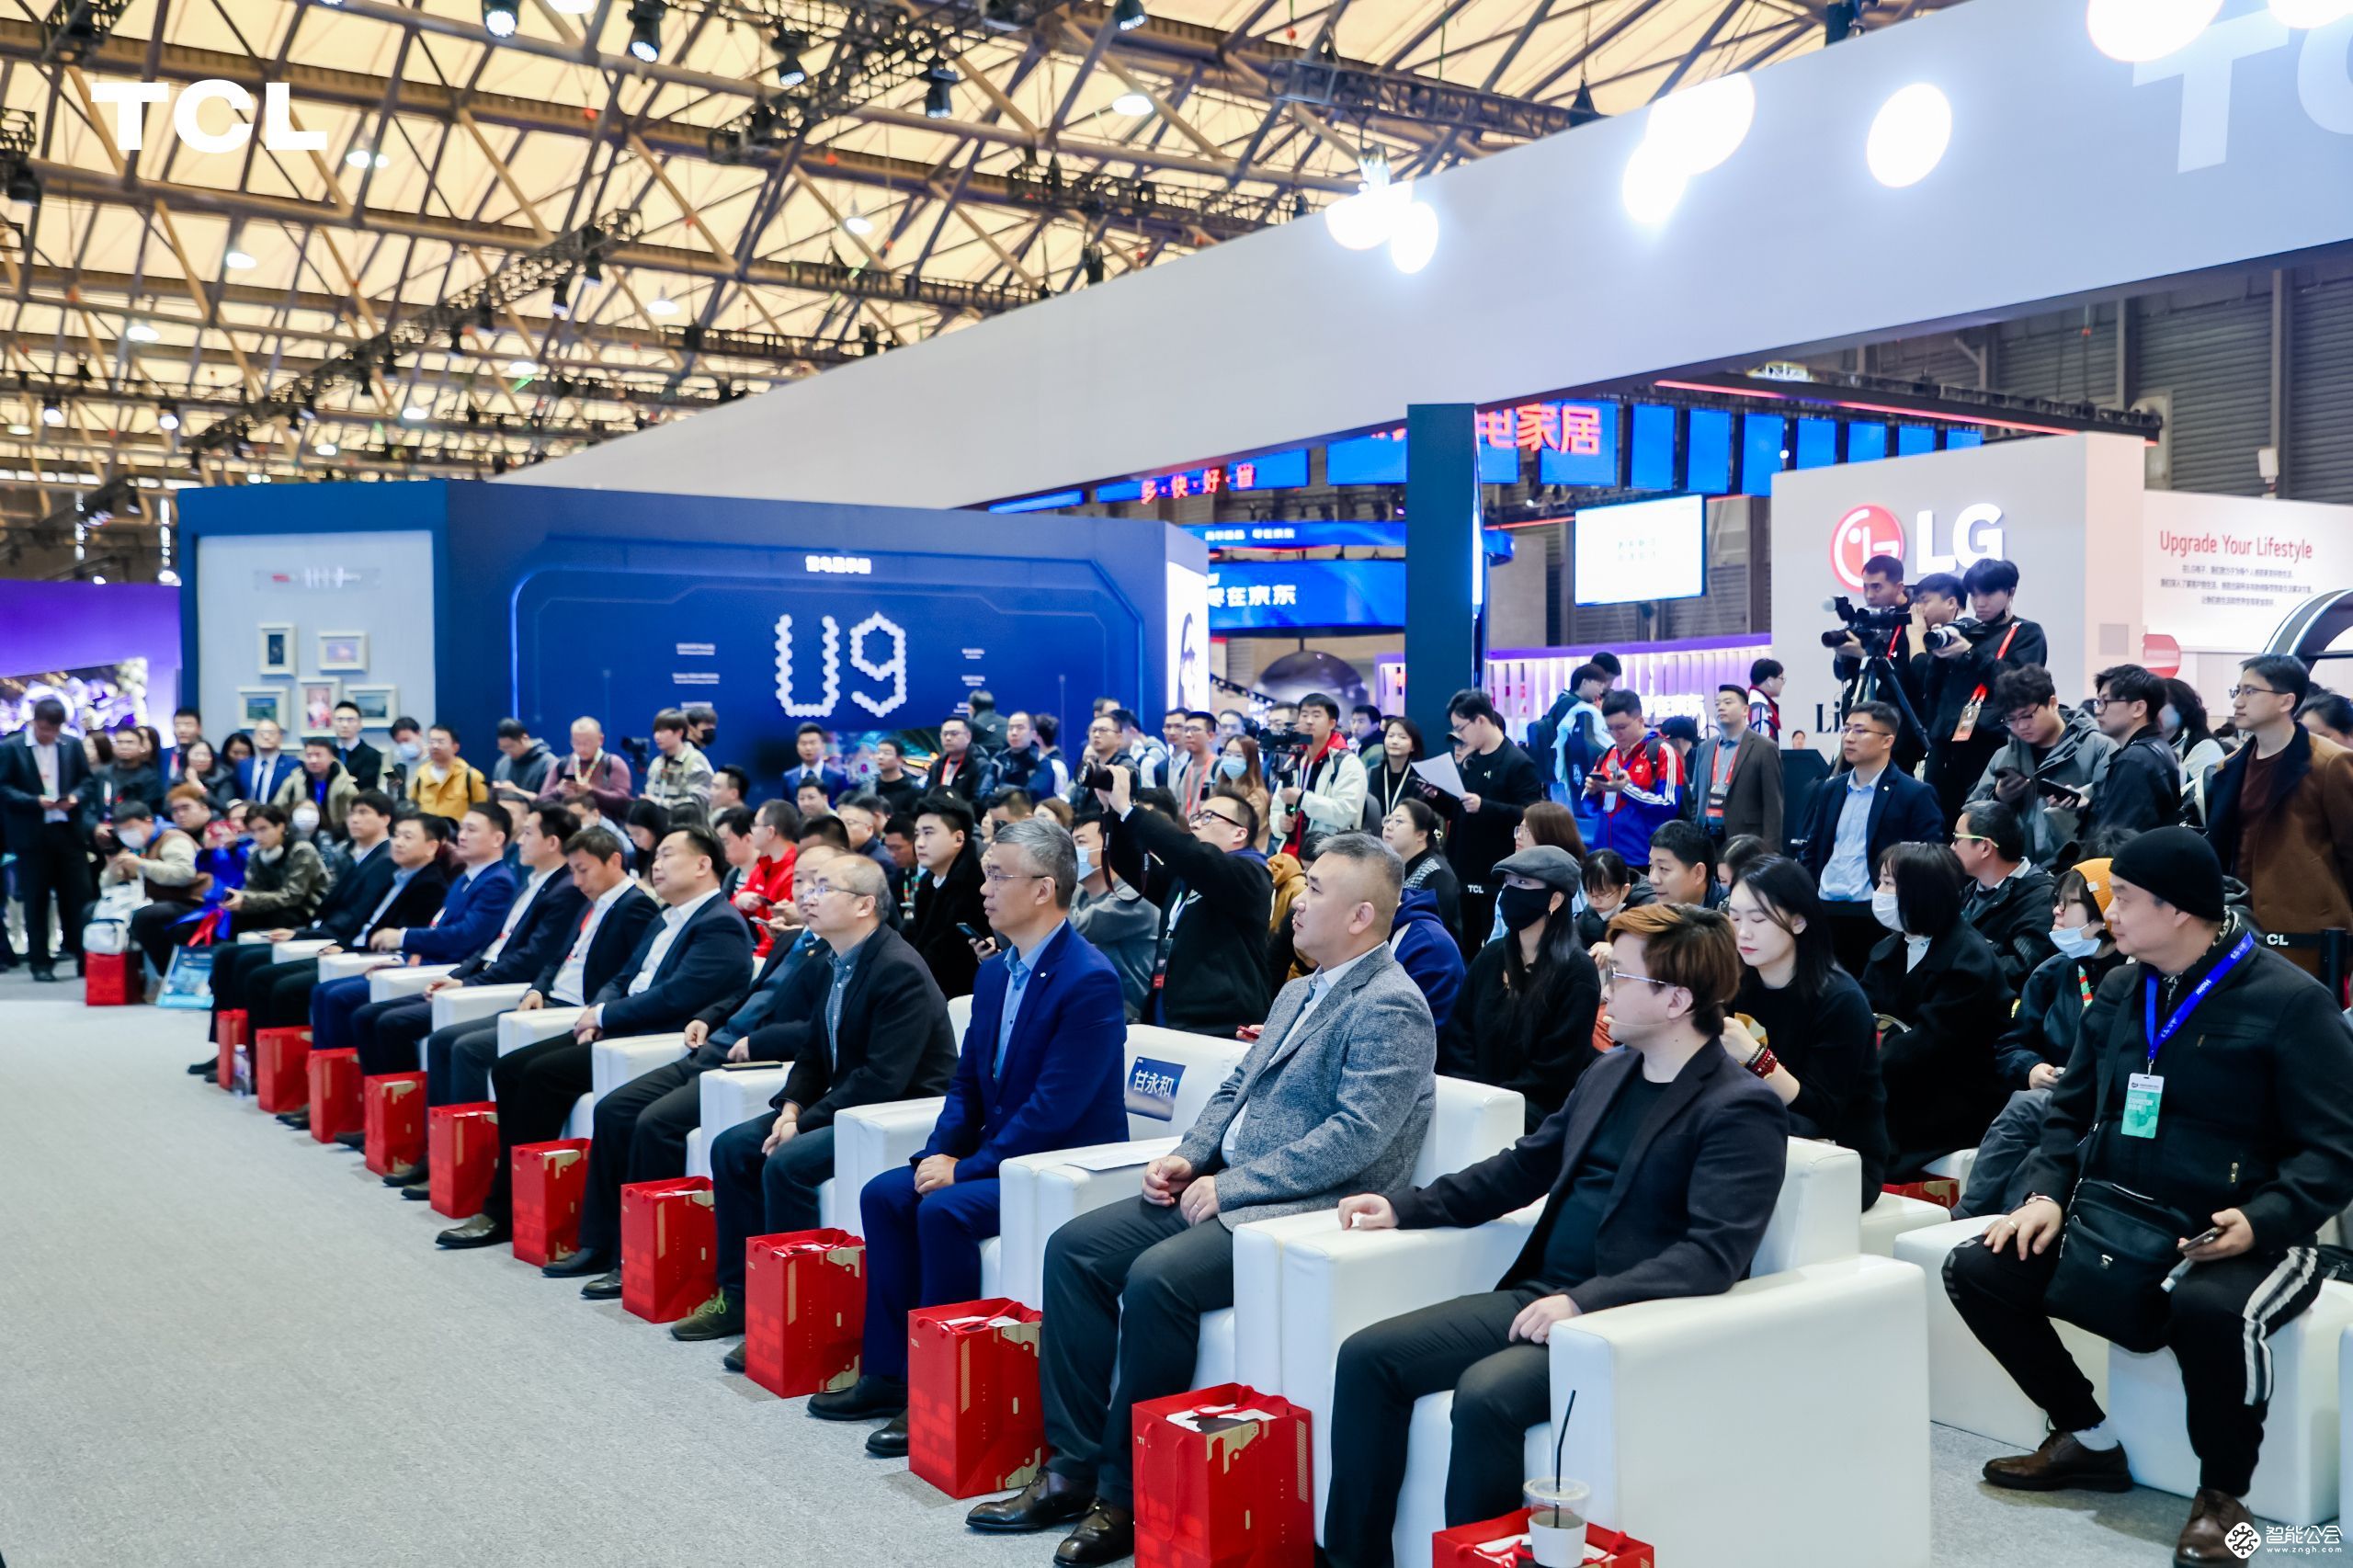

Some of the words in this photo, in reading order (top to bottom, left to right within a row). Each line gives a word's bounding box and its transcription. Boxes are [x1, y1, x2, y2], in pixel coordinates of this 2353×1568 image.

[1916, 504, 2004, 574] LG
[2160, 530, 2218, 558] Upgrade
[2222, 535, 2253, 555] Your
[2256, 537, 2313, 563] Lifestyle
[775, 610, 907, 718] U9
[1467, 884, 1484, 894] TCL
[2266, 933, 2289, 946] CL
[1133, 1069, 1176, 1098] 甘永和
